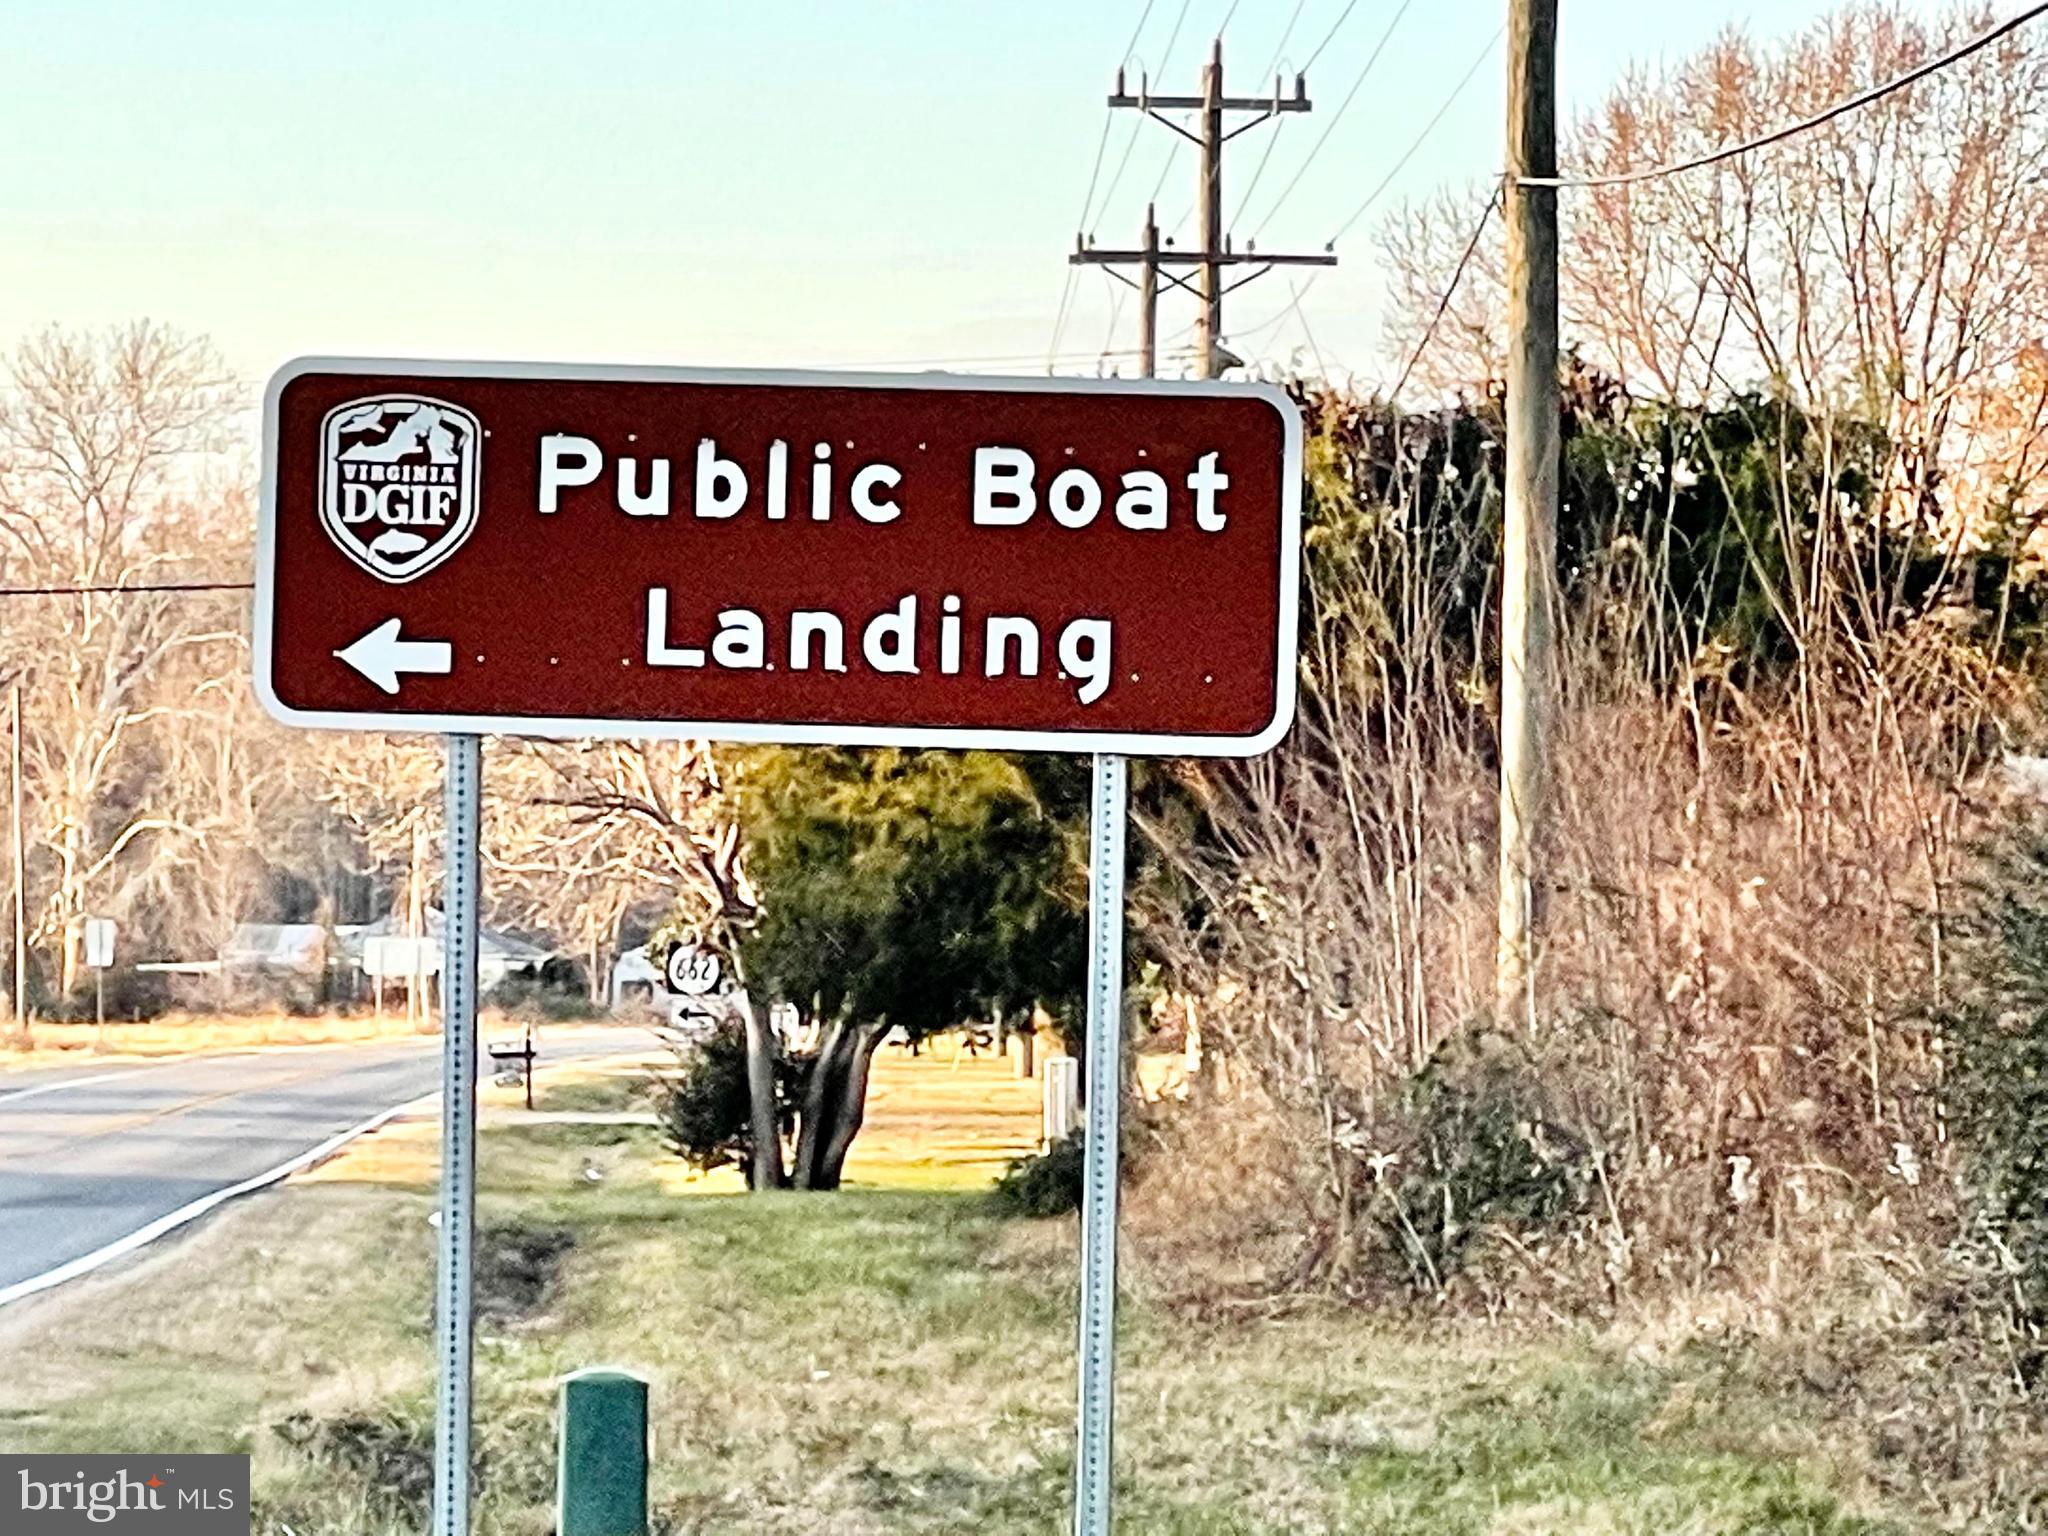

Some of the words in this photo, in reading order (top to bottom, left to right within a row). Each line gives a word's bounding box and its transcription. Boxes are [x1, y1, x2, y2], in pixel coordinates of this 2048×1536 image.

[342, 463, 457, 483] VIRGINIA
[538, 434, 902, 524] Public
[973, 446, 1230, 533] Boat
[342, 483, 458, 526] DGIF
[646, 587, 1113, 705] Landing
[675, 953, 711, 981] 662
